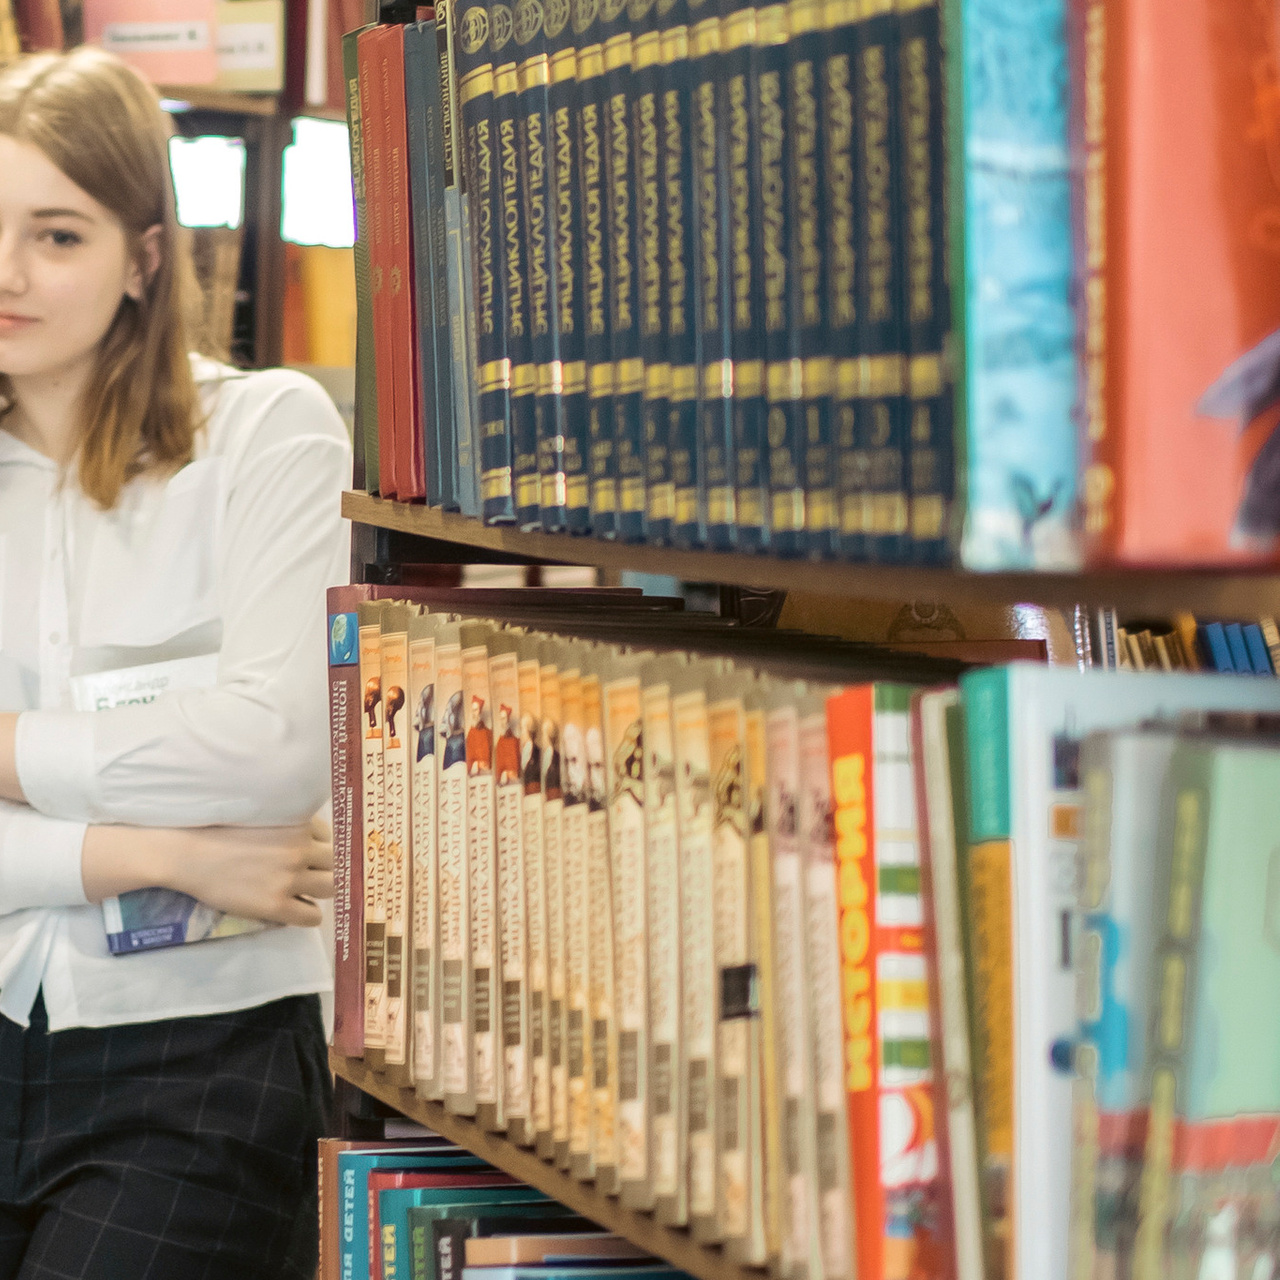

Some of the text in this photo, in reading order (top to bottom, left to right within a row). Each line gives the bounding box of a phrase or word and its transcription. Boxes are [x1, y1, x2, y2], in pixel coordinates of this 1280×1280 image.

[439, 50, 453, 171] ЕСТЕСТВОЗНАНИЕ
[610, 94, 632, 333] ЭНЦИКЛОПЕДИЯ
[639, 92, 662, 335] ЭНЦИКЛОПЕДИЯ
[477, 121, 493, 334] ЭНЦИКЛОПЕДИЯ
[499, 118, 524, 336] ЭНЦИКЛОПЕДИЯ
[526, 112, 548, 336] ЭНЦИКЛОПЕДИЯ
[555, 106, 574, 335] ЭНЦИКЛОПЕДИЯ
[582, 103, 605, 336] ЭНЦИКЛОПЕДИЯ
[338, 680, 348, 742] НОВЫЙ
[364, 751, 375, 908] ШКОЛЬНАЯ
[385, 761, 395, 921] ШКОЛЬНАЯ
[342, 1169, 355, 1243] ДЕТЕЙ
